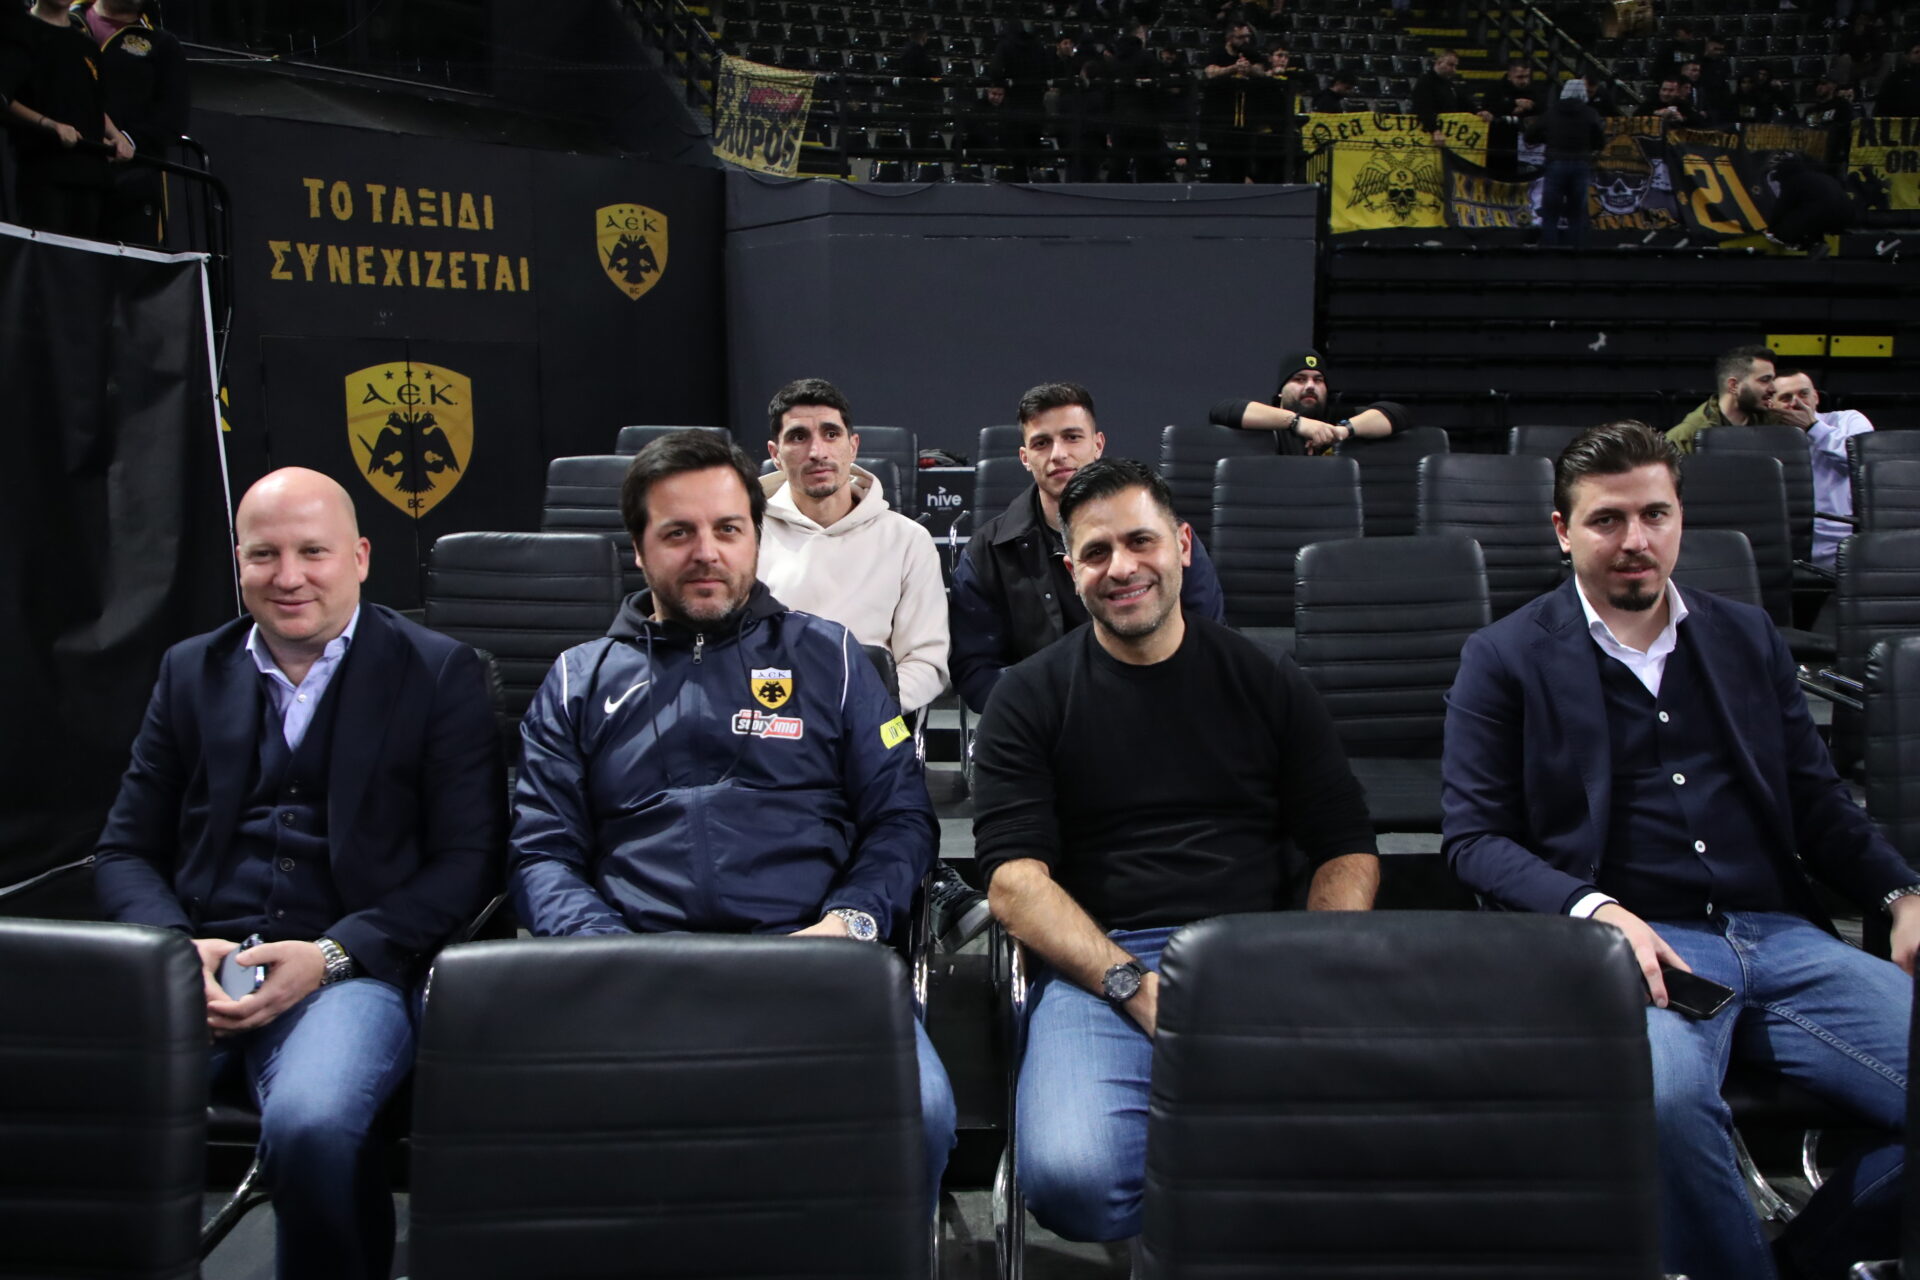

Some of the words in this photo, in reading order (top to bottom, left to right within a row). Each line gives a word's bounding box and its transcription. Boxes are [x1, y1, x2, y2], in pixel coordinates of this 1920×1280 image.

[366, 183, 494, 230] ΤΑΞΙΔΙ
[1683, 153, 1768, 234] 21
[268, 240, 531, 292] ΣΥΝΕΧΙΖΕΤΑΙ
[927, 486, 962, 507] hive
